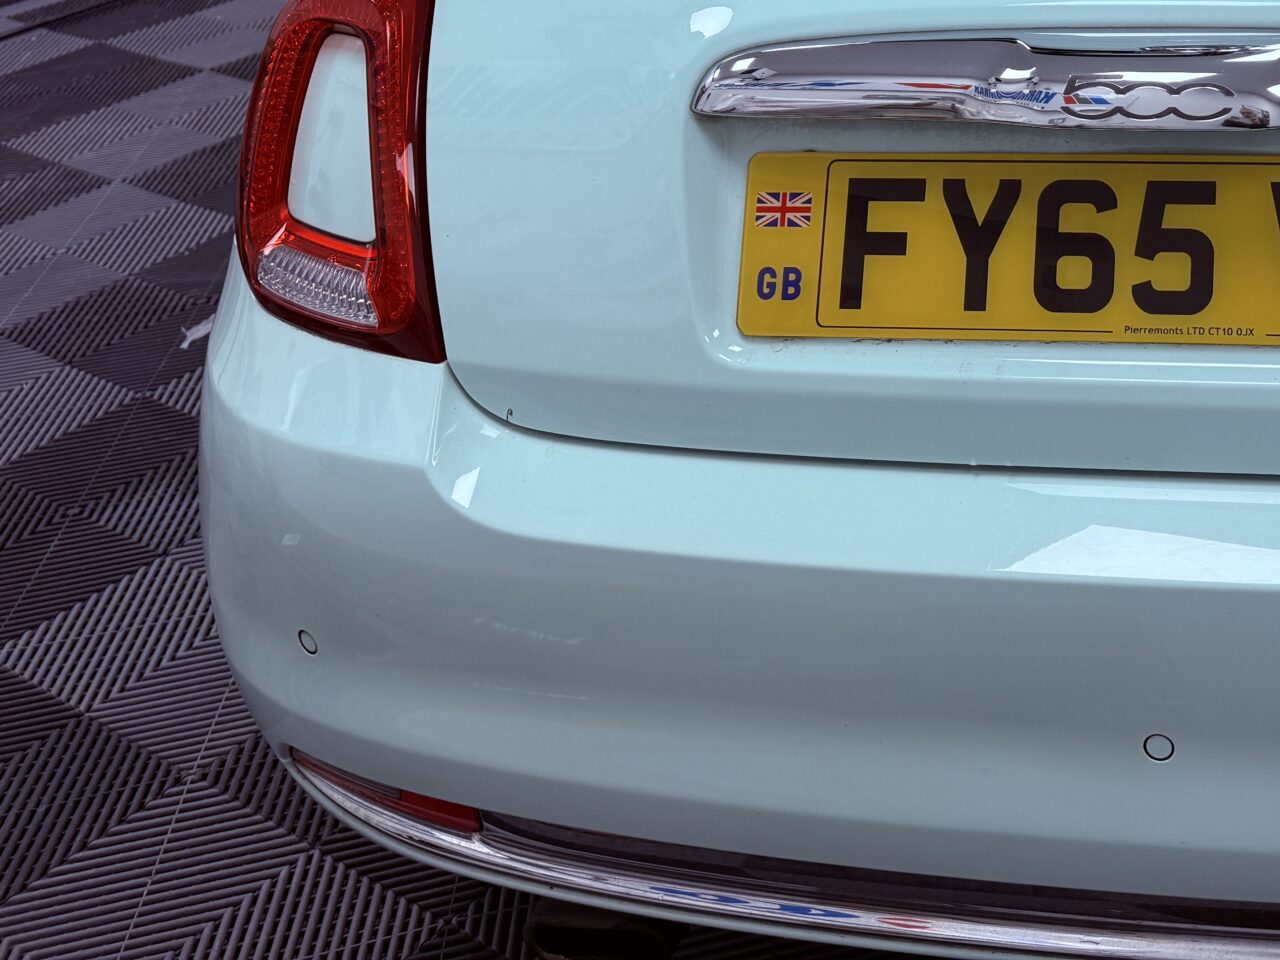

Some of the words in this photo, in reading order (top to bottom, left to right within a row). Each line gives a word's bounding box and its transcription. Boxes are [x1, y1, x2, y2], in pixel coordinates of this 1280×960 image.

[839, 178, 1217, 315] FY65
[756, 266, 802, 301] GB
[1124, 325, 1184, 335] Pierremonts
[1187, 326, 1205, 336] LTD
[1208, 327, 1233, 336] CT10
